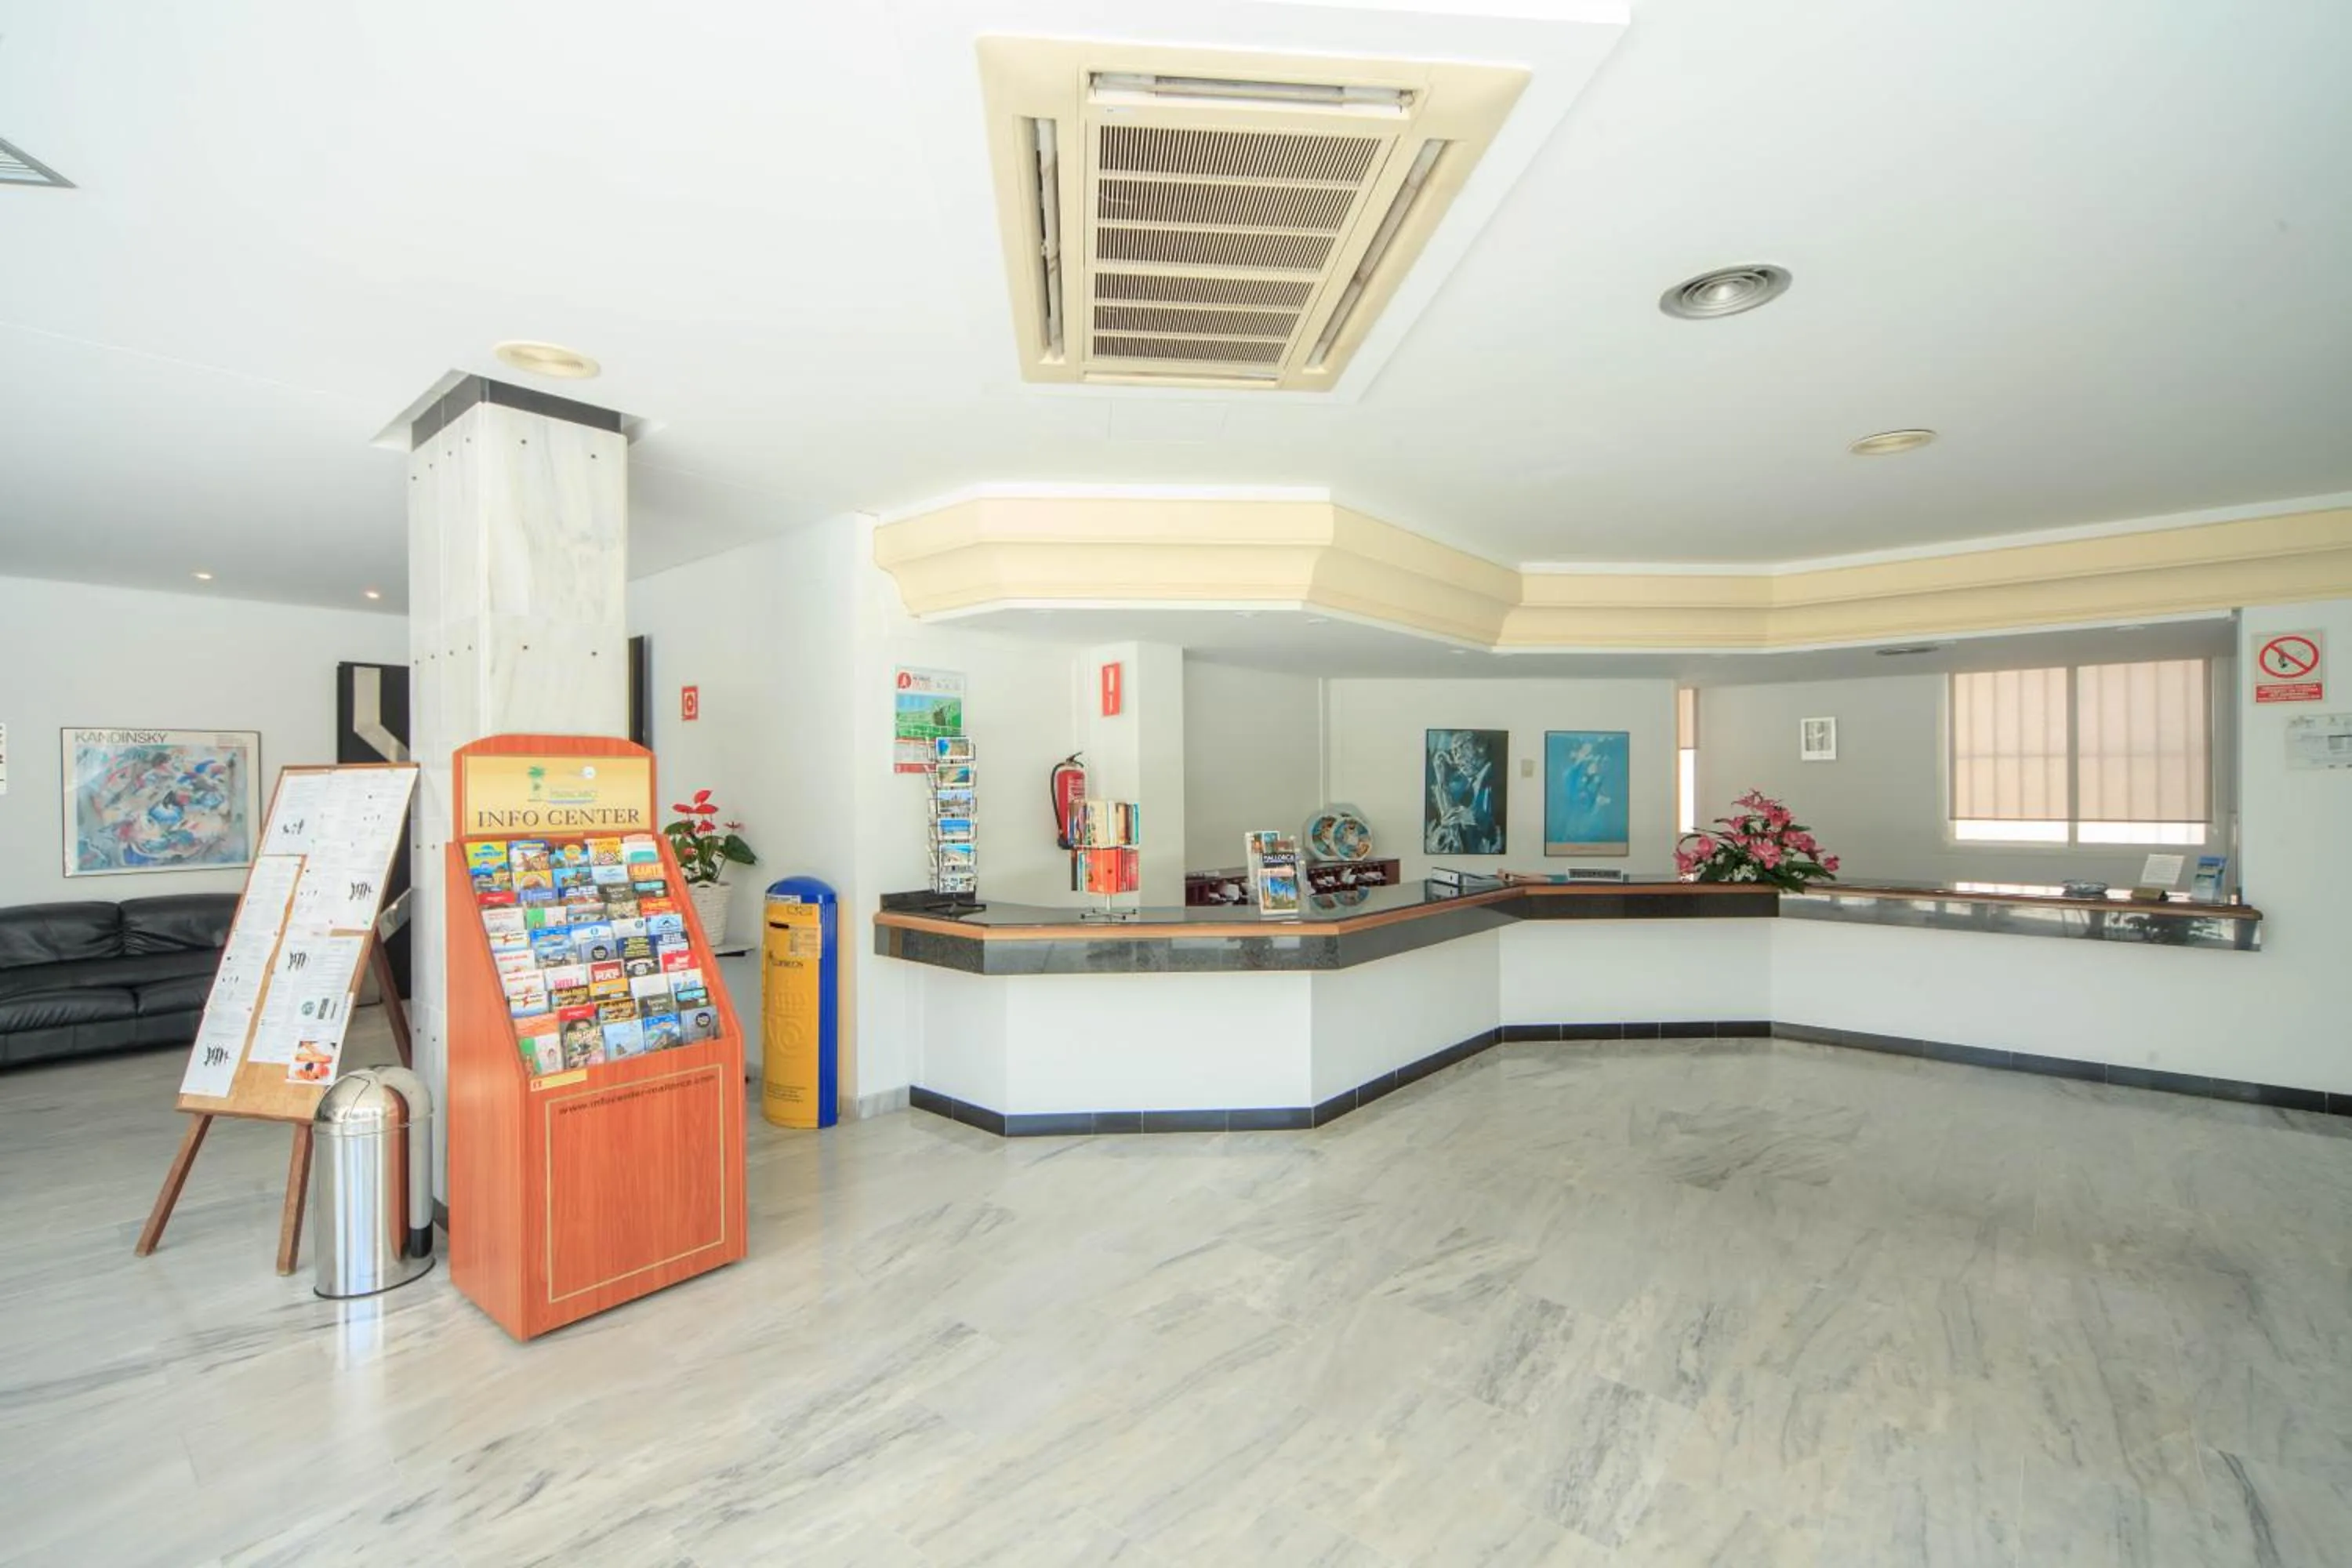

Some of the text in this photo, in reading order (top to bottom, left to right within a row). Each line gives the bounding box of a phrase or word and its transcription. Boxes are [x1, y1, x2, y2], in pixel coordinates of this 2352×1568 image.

[74, 731, 168, 743] KANDINSKY
[477, 808, 641, 827] INFO CENTER
